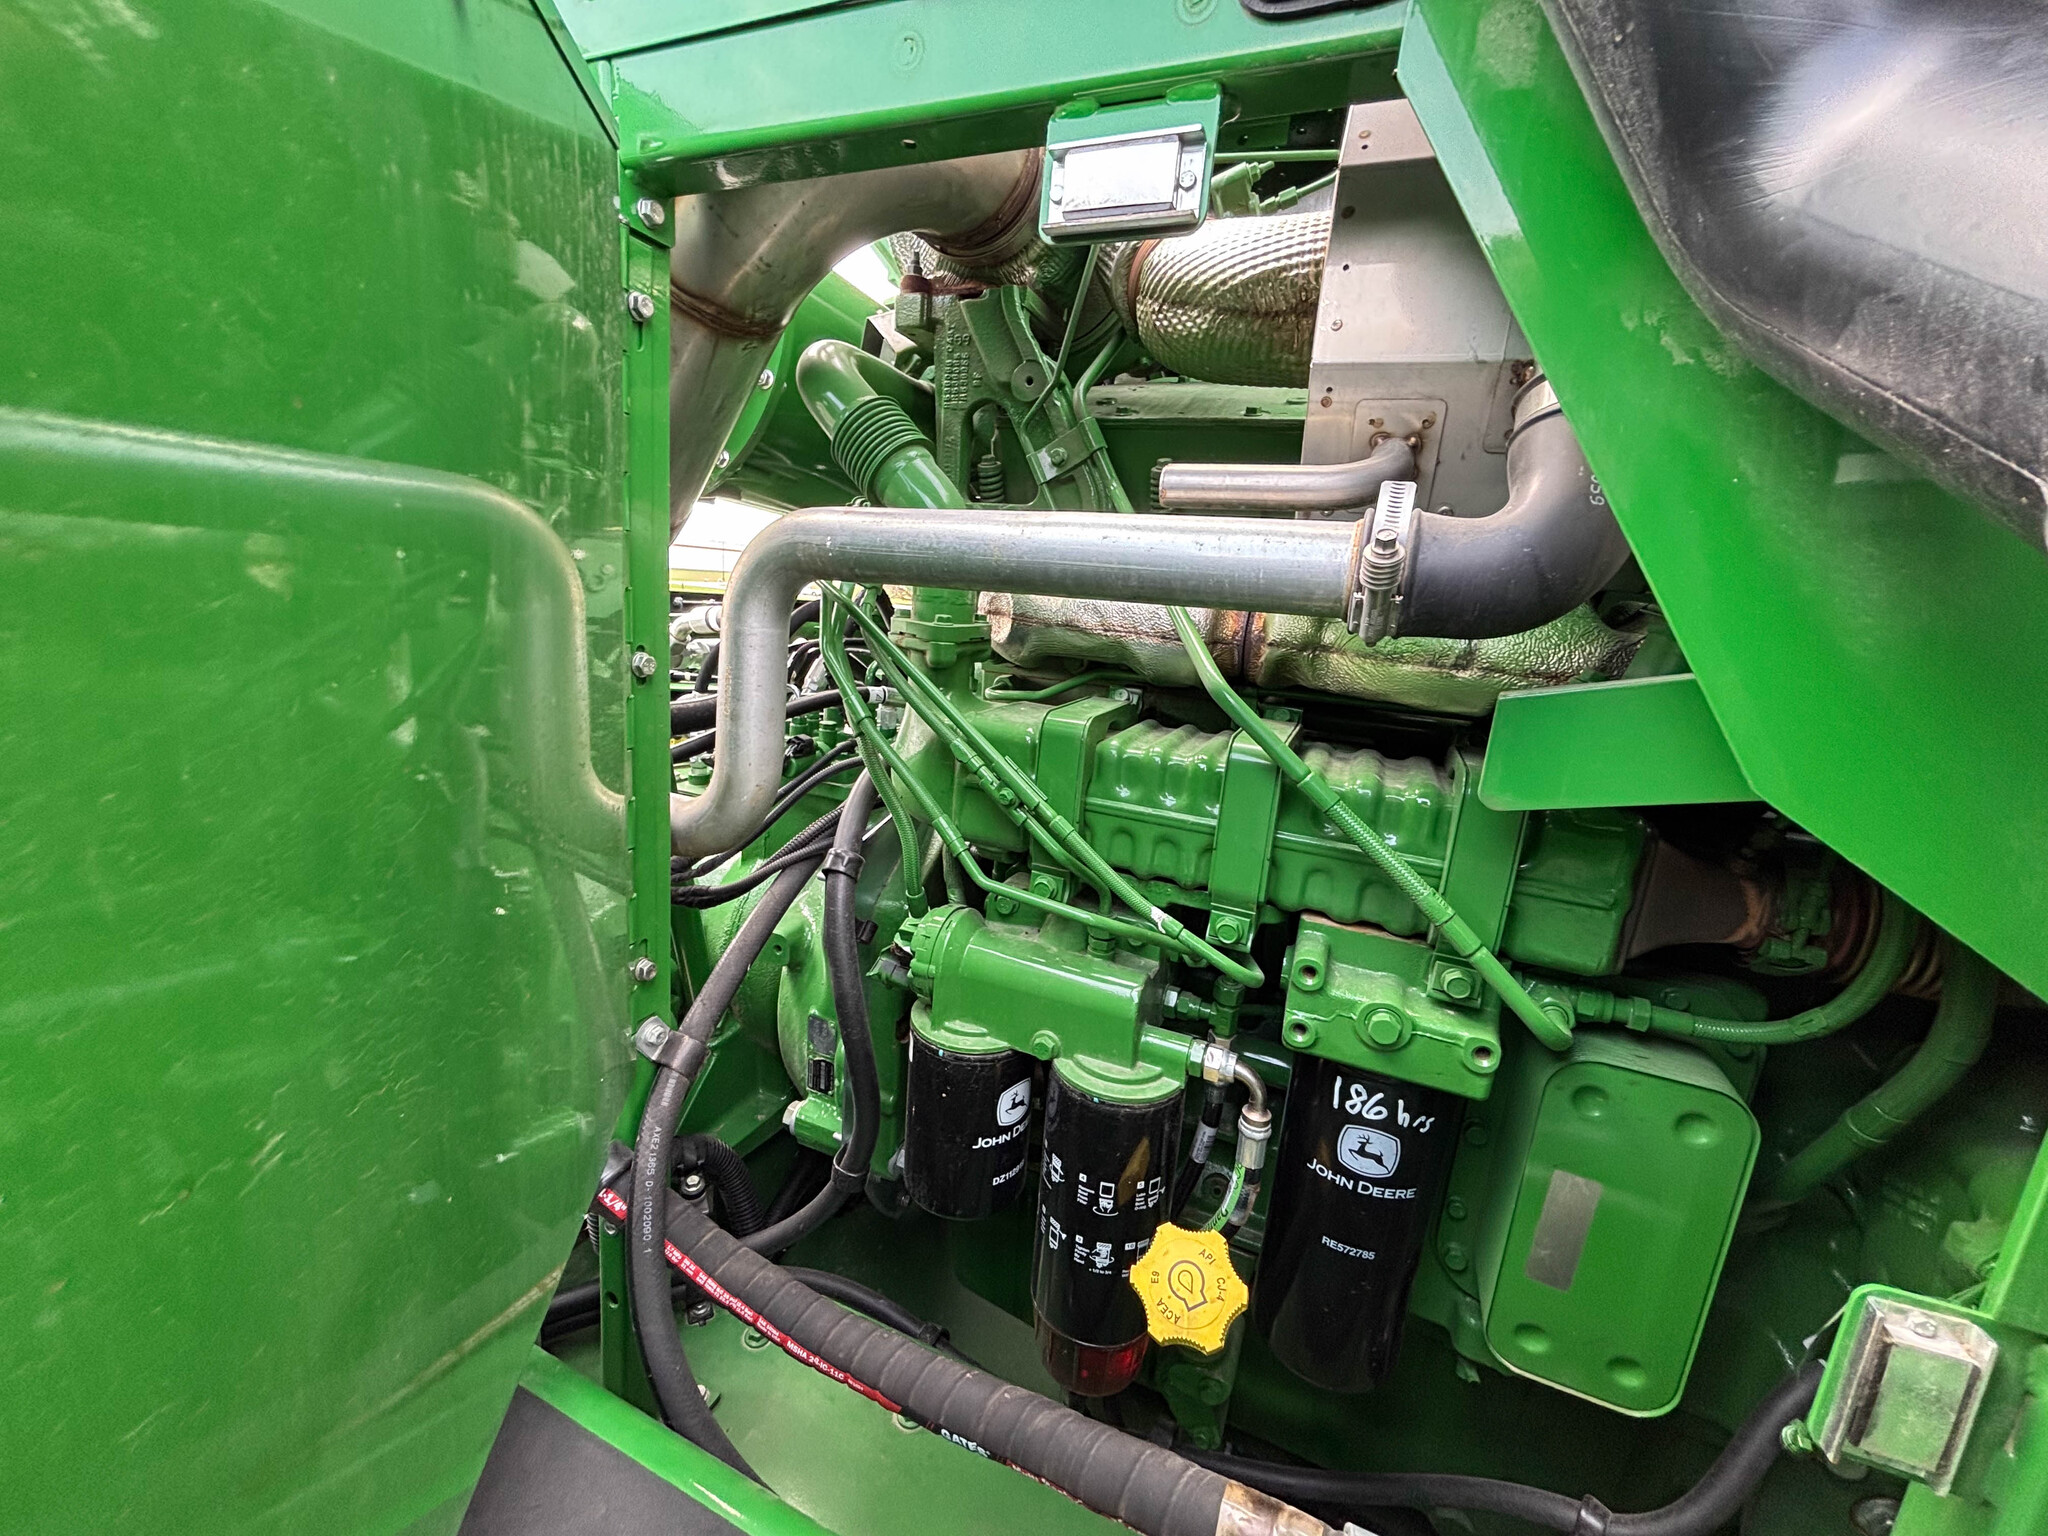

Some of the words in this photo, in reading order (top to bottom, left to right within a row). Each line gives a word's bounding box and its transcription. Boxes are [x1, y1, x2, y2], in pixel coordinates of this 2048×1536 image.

[1332, 1075, 1389, 1121] 186
[1397, 1098, 1436, 1134] hrs
[971, 1131, 1011, 1150] JOHN
[1306, 1158, 1354, 1190] JOHN
[1357, 1180, 1418, 1200] DEERE
[1321, 1235, 1377, 1260] RE572785
[1150, 1270, 1160, 1284] E9
[1198, 1248, 1217, 1266] API
[1216, 1277, 1227, 1302] CJ-4
[1156, 1298, 1182, 1325] ACEA
[786, 1340, 808, 1360] MSHA
